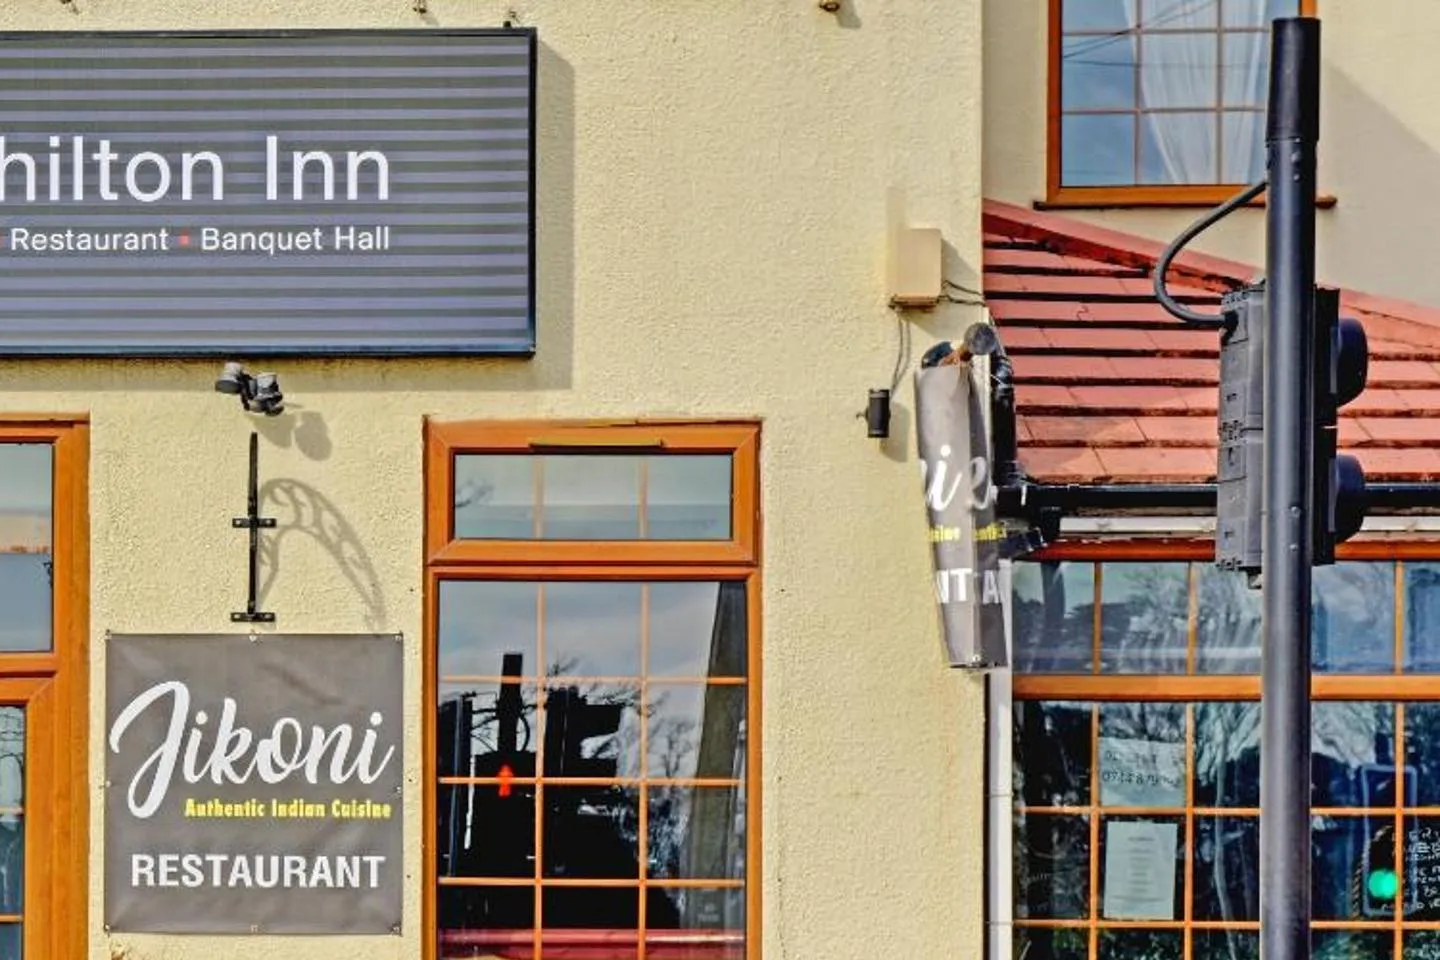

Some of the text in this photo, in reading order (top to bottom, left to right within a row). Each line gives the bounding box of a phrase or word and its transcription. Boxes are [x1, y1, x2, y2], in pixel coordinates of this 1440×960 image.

[266, 135, 389, 201] Inn
[10, 227, 170, 251] Restaurant
[201, 227, 323, 255] Banquet
[334, 226, 390, 250] Hall
[109, 681, 396, 819] Jikoni
[184, 798, 392, 818] Authentic Indian Cuisine
[130, 853, 386, 889] RESTAURANT
